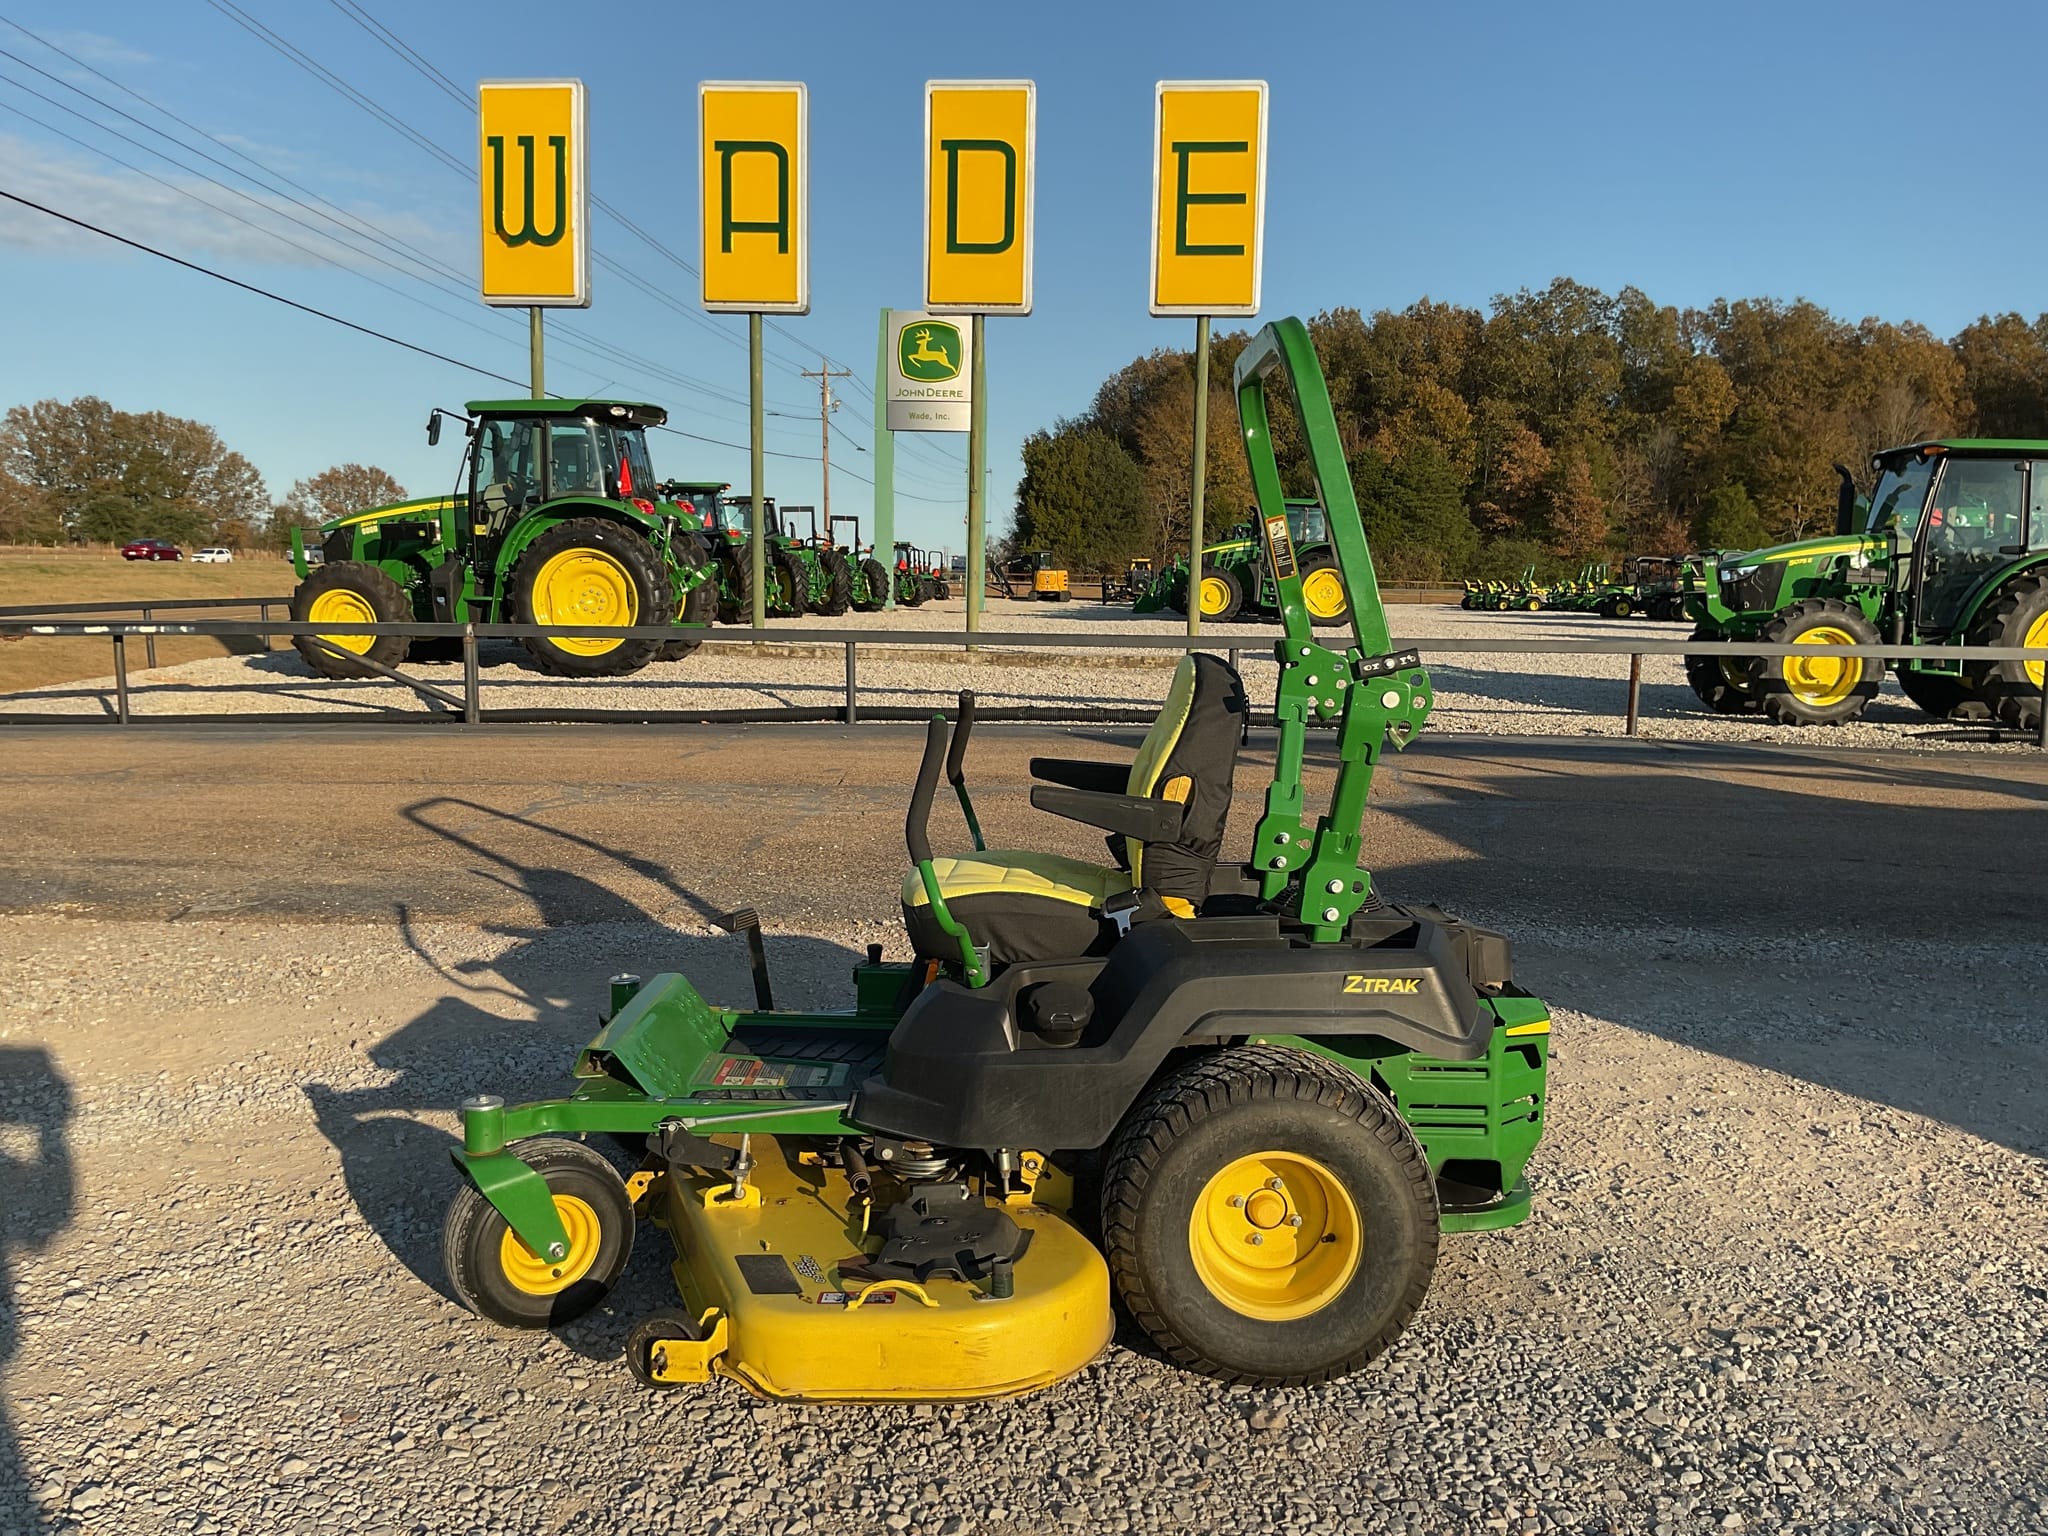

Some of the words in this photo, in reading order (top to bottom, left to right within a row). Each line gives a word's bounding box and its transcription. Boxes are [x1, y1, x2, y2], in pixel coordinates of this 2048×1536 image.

[896, 388, 925, 398] JOHN
[926, 388, 964, 398] DEERE
[908, 411, 932, 421] Wade,
[935, 411, 950, 421] Inc.
[1343, 975, 1421, 993] ZTRAK
